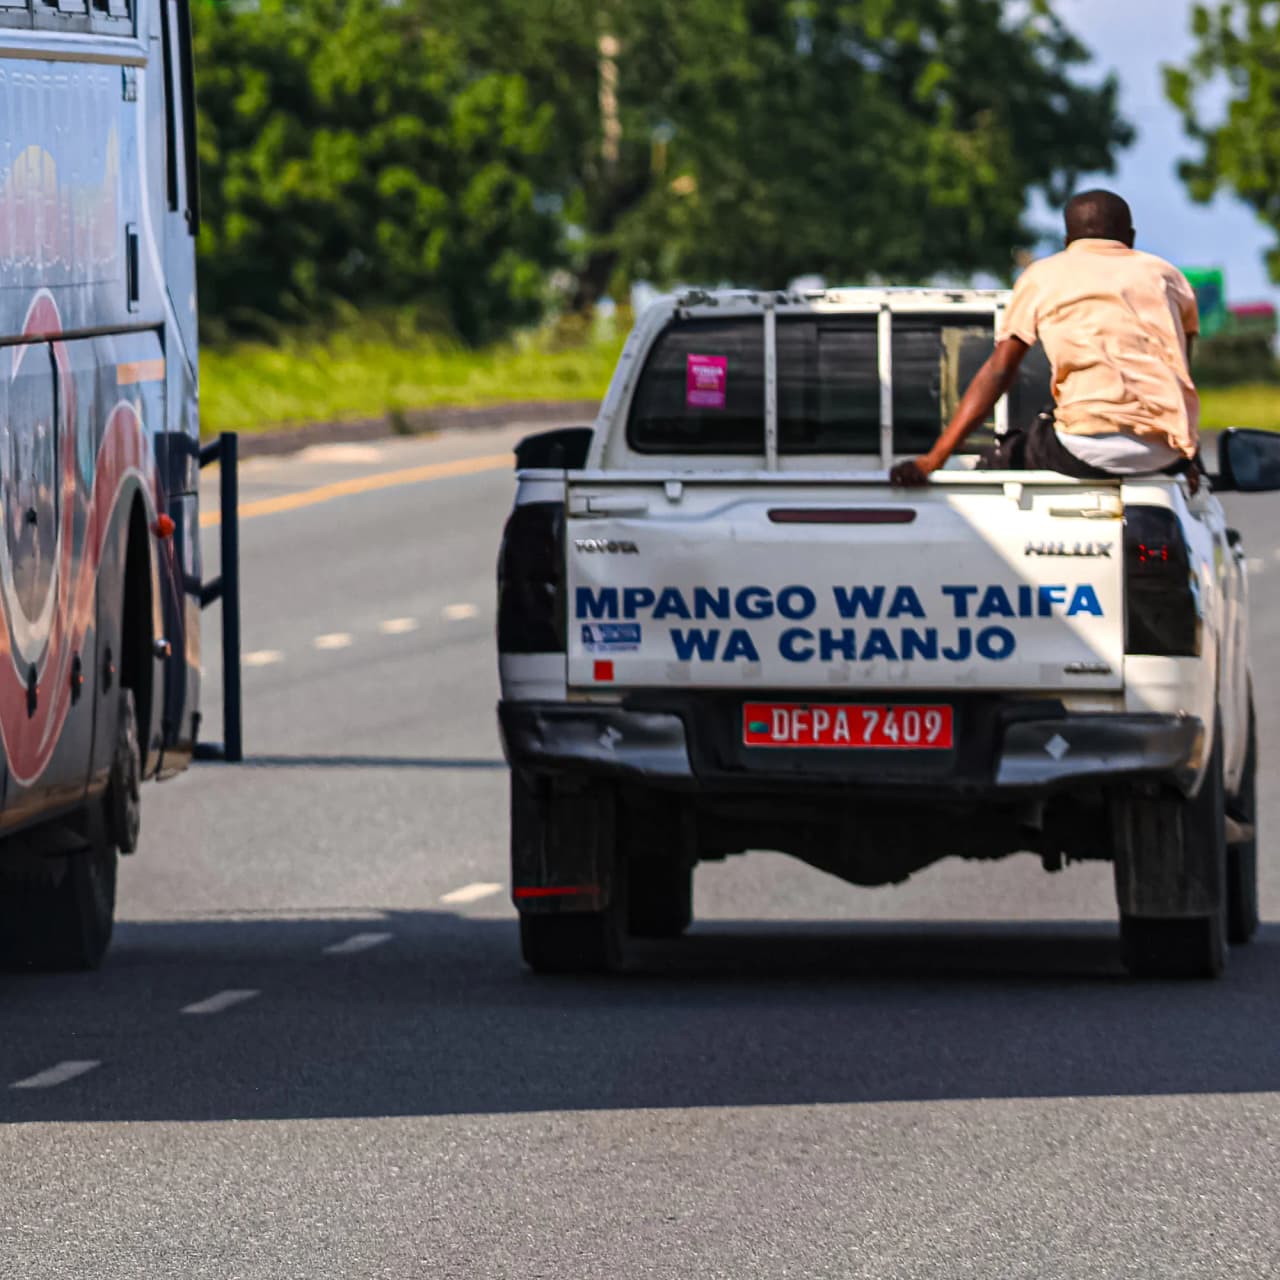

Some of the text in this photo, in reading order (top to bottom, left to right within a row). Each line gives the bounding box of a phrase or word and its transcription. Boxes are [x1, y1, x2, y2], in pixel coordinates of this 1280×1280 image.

[574, 539, 639, 554] TOYOTA
[1025, 540, 1113, 558] HILUX
[575, 584, 1104, 619] MPANGO WA TAIFA
[670, 627, 760, 662] WA
[778, 626, 1017, 662] CHANJO
[772, 708, 941, 742] DFPA 7409
